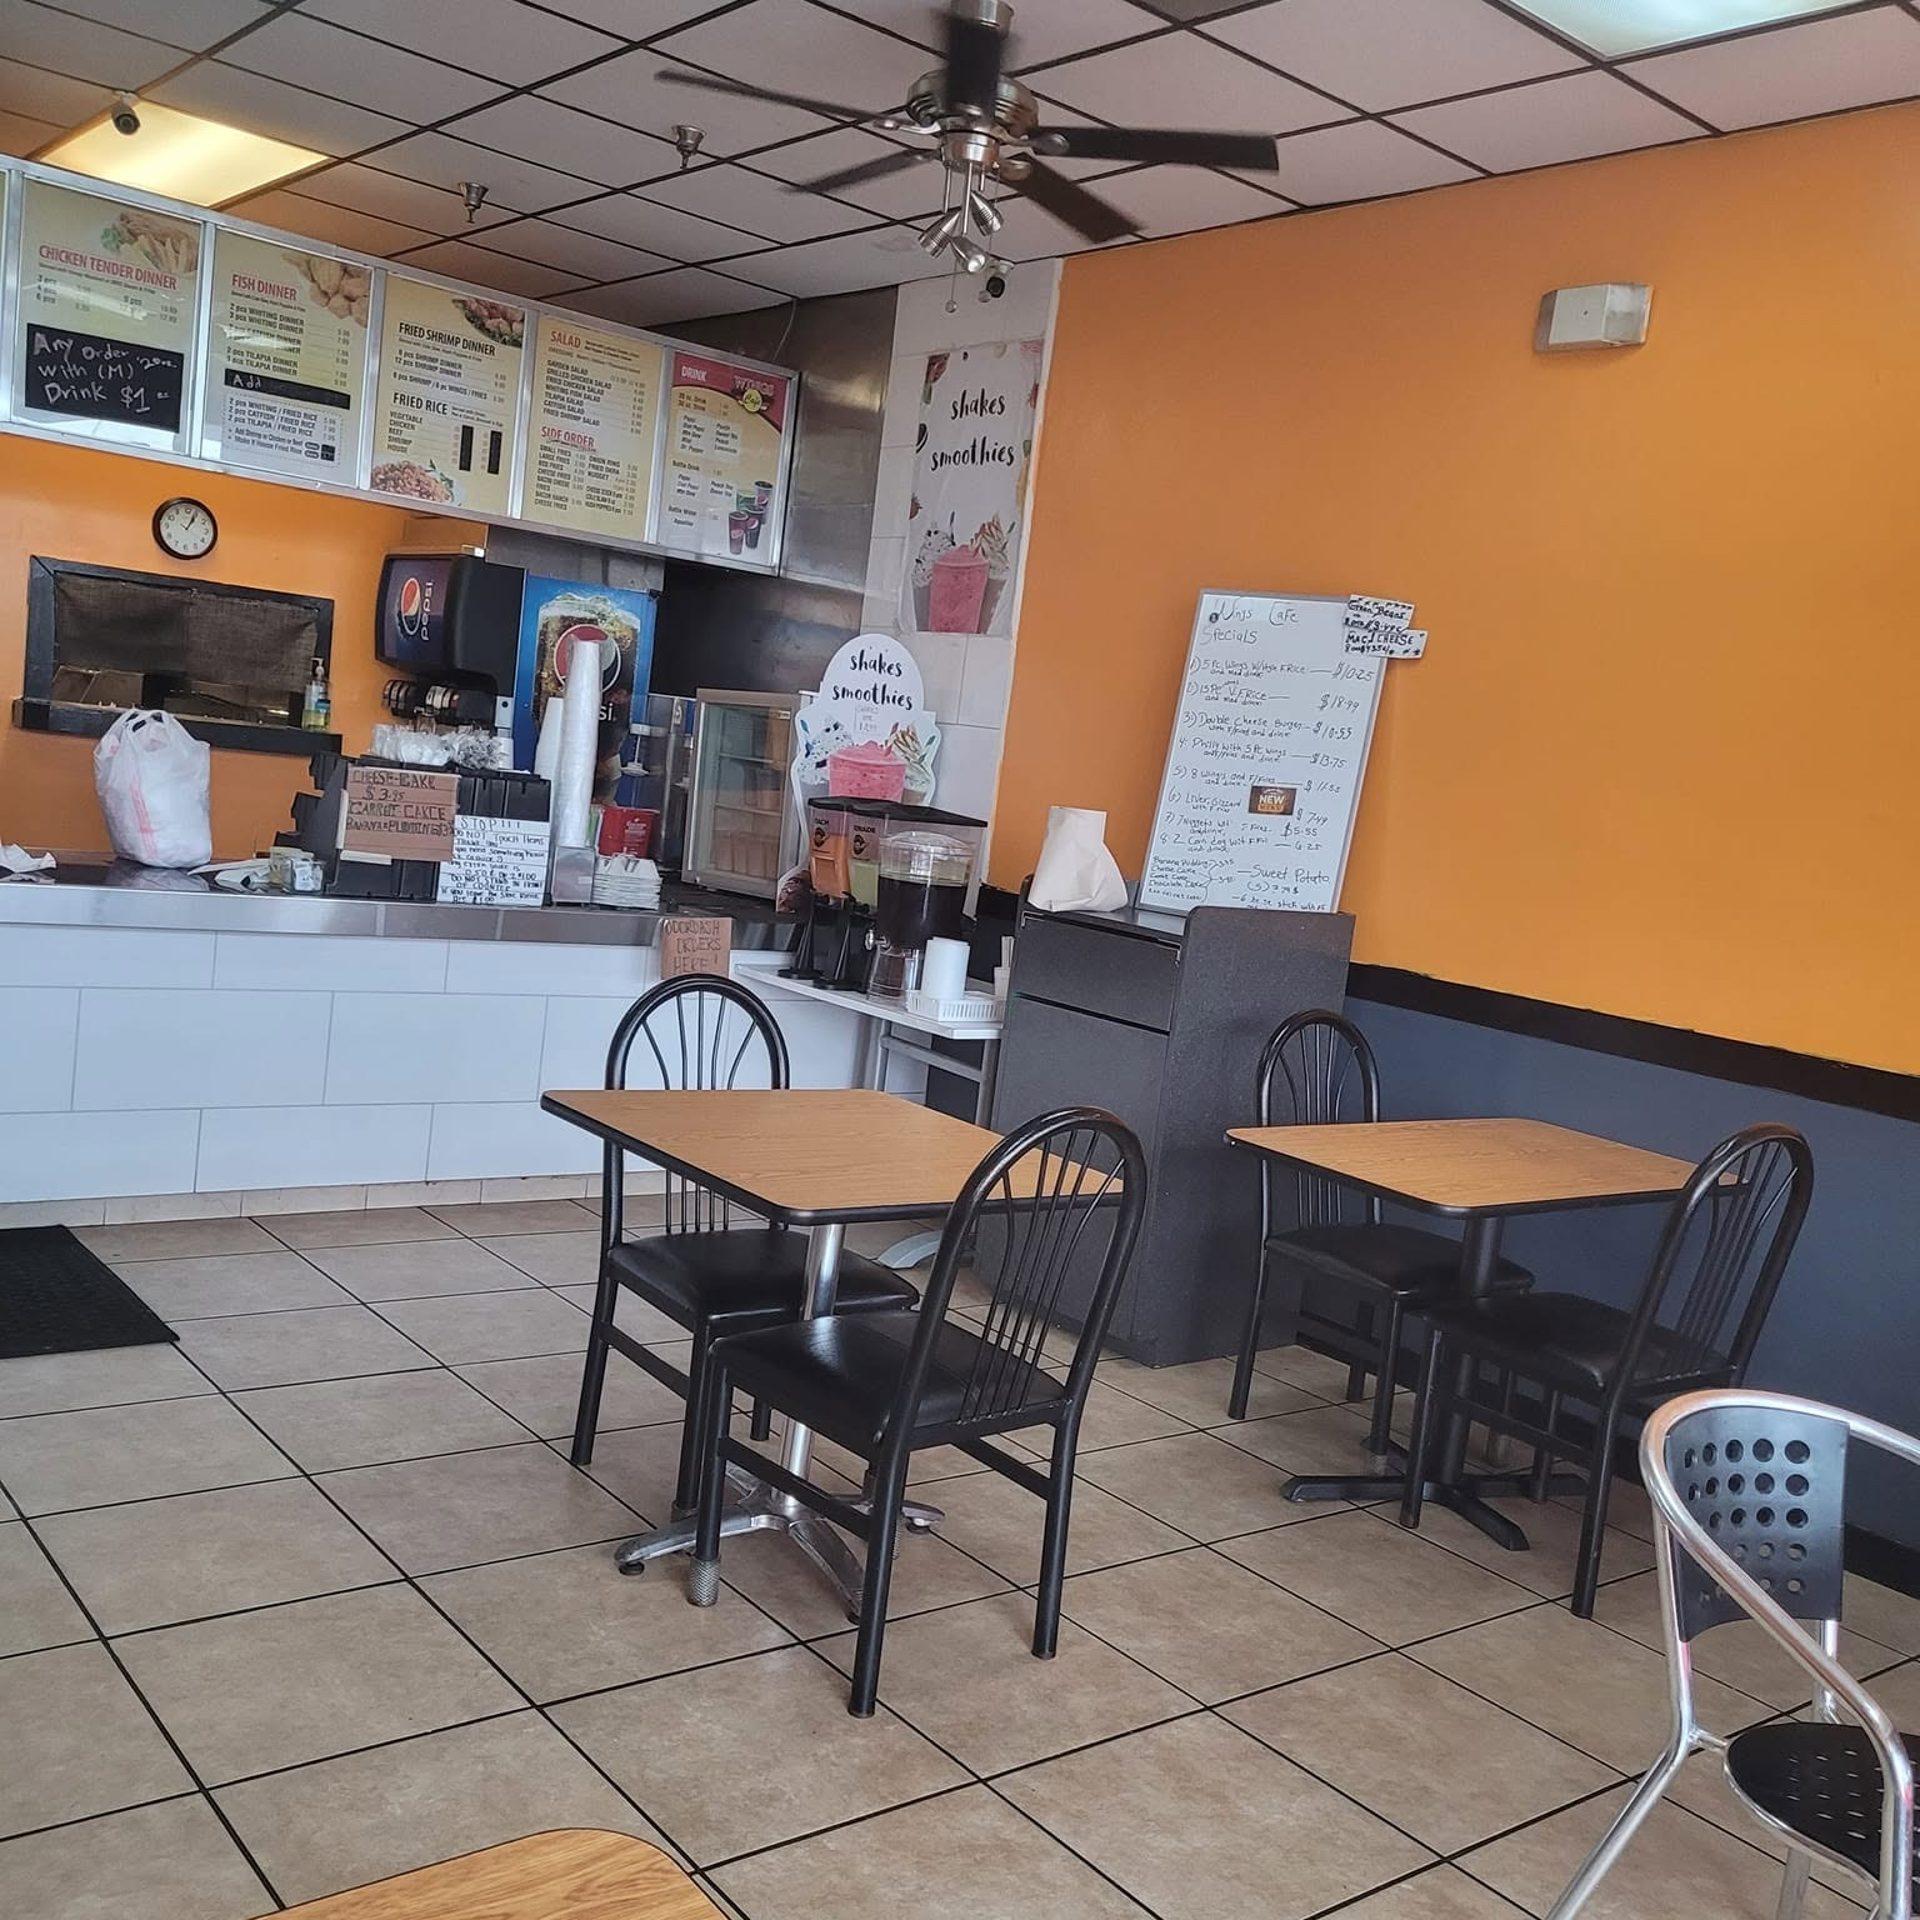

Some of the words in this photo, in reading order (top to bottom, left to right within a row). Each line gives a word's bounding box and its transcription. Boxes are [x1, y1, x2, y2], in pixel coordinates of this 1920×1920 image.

[39, 244, 88, 268] CHICKEN
[89, 256, 134, 279] TENDER
[135, 269, 177, 290] DINNER
[231, 274, 255, 290] FISH
[257, 280, 297, 301] DINNER
[248, 306, 278, 321] WHITING
[248, 315, 278, 329] WHITING
[33, 332, 74, 362] Any
[399, 322, 425, 339] FRIED
[425, 328, 461, 347] SHRIMP
[462, 338, 496, 356] DINNER
[550, 330, 581, 349] SALAD
[245, 359, 271, 371] TILAPIA
[246, 350, 271, 363] TILAPIA
[98, 363, 134, 380] (M)
[570, 364, 588, 375] SALAD
[681, 365, 707, 382] DRINK
[563, 379, 586, 391] CHICKEN
[587, 386, 605, 396] SALAD
[570, 372, 593, 385] CHICKEN
[594, 380, 612, 390] SALAD
[44, 381, 108, 404] Drink
[544, 391, 565, 402] TILAPIA
[566, 397, 584, 407] SALAD
[583, 392, 601, 403] SALAD
[393, 392, 423, 410] FRIED
[425, 399, 448, 416] RICE
[567, 404, 585, 415] SALAD
[950, 387, 1006, 421] shakes
[247, 418, 272, 429] TILAPIA
[389, 419, 416, 431] CHICKEN
[390, 411, 423, 424] VEGETABLE
[582, 417, 600, 426] SALAD
[541, 426, 562, 440] SIDE
[563, 431, 595, 448] ORDER
[930, 435, 1015, 472] smoothies
[849, 649, 903, 677] shakes
[832, 682, 914, 711] smoothies
[1198, 711, 1231, 727] Double
[1259, 794, 1286, 805] NEW
[1250, 864, 1289, 880] Sweet
[1294, 868, 1330, 886] Potato
